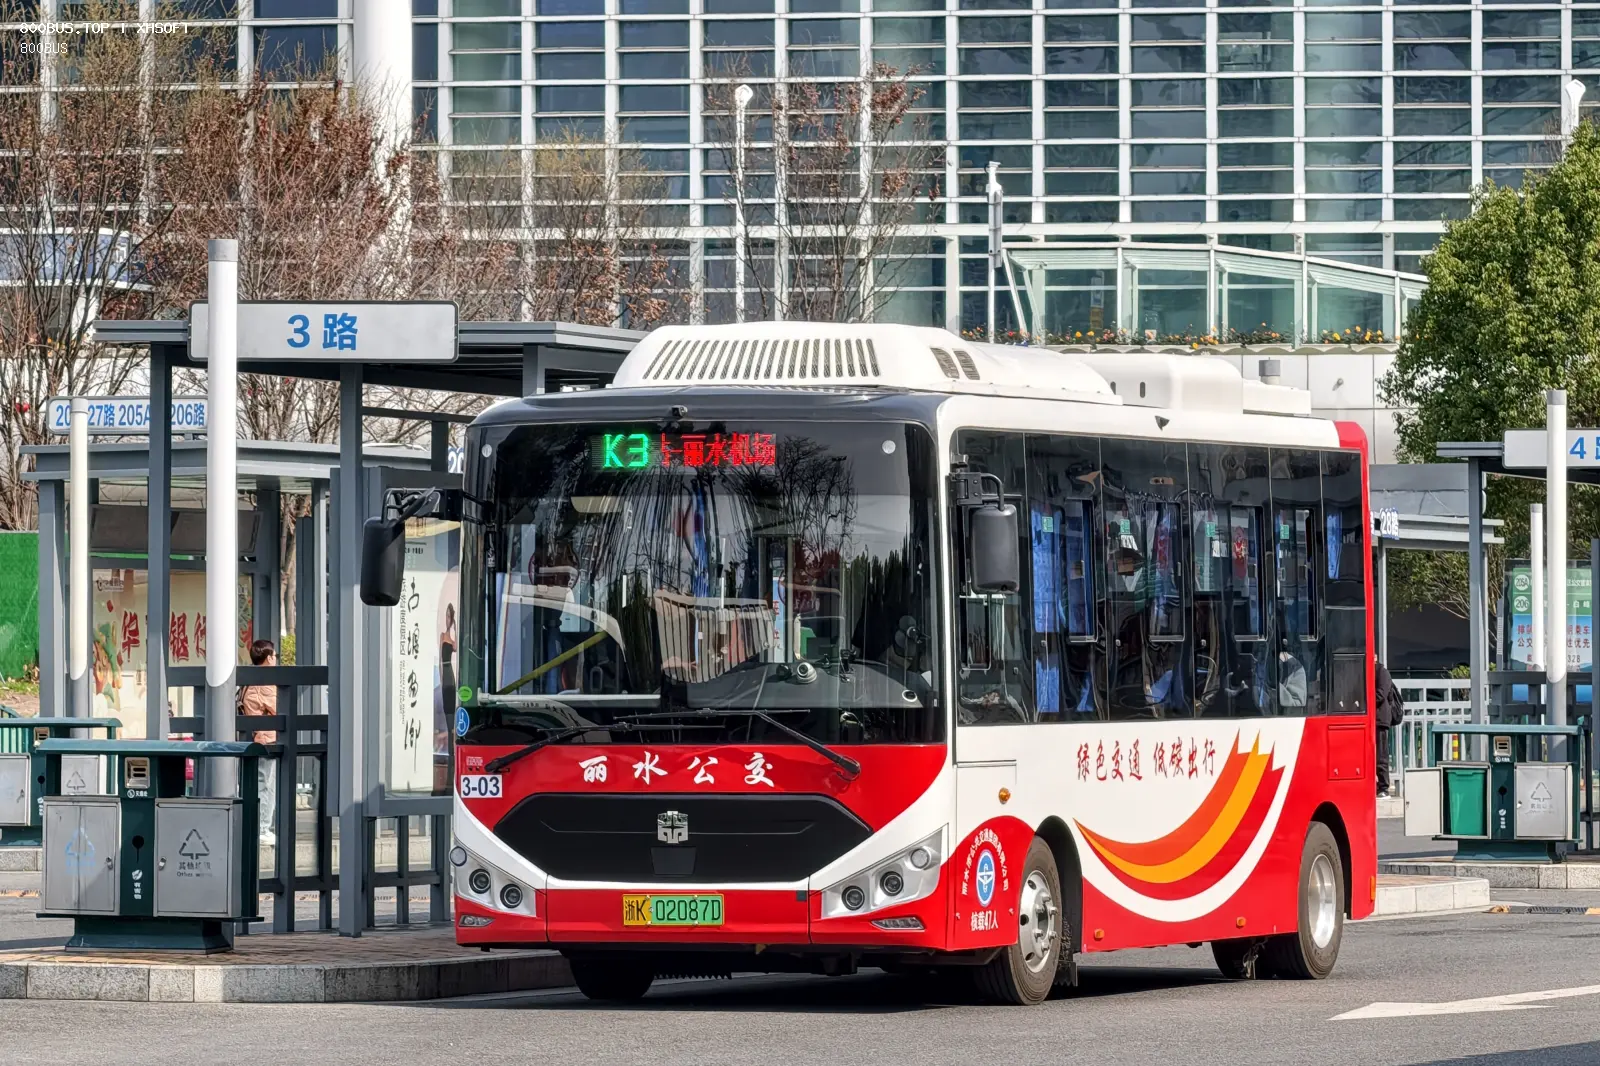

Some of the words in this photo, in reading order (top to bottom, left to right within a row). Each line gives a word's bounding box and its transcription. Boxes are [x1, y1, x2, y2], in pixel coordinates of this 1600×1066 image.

[56, 405, 71, 426] 20
[118, 404, 150, 426] 205A
[603, 433, 649, 468] K3
[1515, 599, 1529, 609] 206
[1567, 654, 1581, 663] 328
[579, 751, 775, 787] 丽水公交
[1077, 739, 1142, 782] 绿色交通
[1154, 736, 1216, 779] 低碳出行
[462, 776, 500, 796] 3-03
[625, 900, 647, 921] 浙K
[655, 900, 721, 921] 02087D
